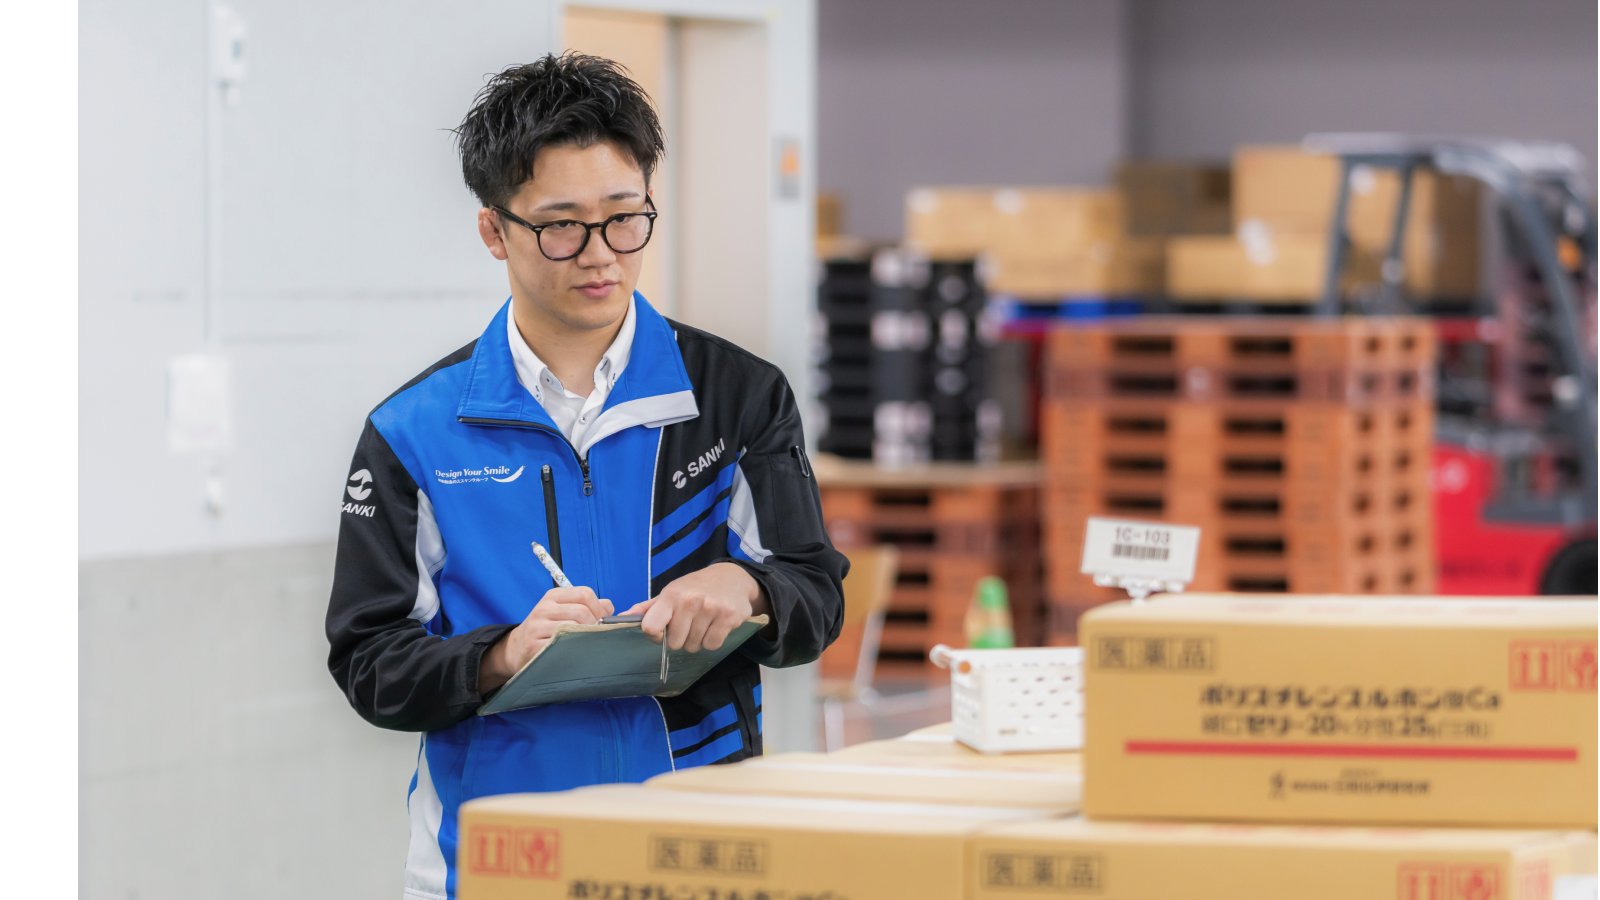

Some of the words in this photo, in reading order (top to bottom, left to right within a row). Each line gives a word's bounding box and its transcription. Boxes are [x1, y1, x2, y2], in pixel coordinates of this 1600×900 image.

[435, 469, 462, 480] Design
[463, 468, 483, 476] Your
[483, 465, 511, 476] Smile
[687, 437, 726, 478] SANKI
[1114, 526, 1171, 545] 1C-103
[1096, 636, 1207, 671] 医薬品
[653, 836, 760, 875] 医薬品
[985, 852, 1095, 889] 医薬品
